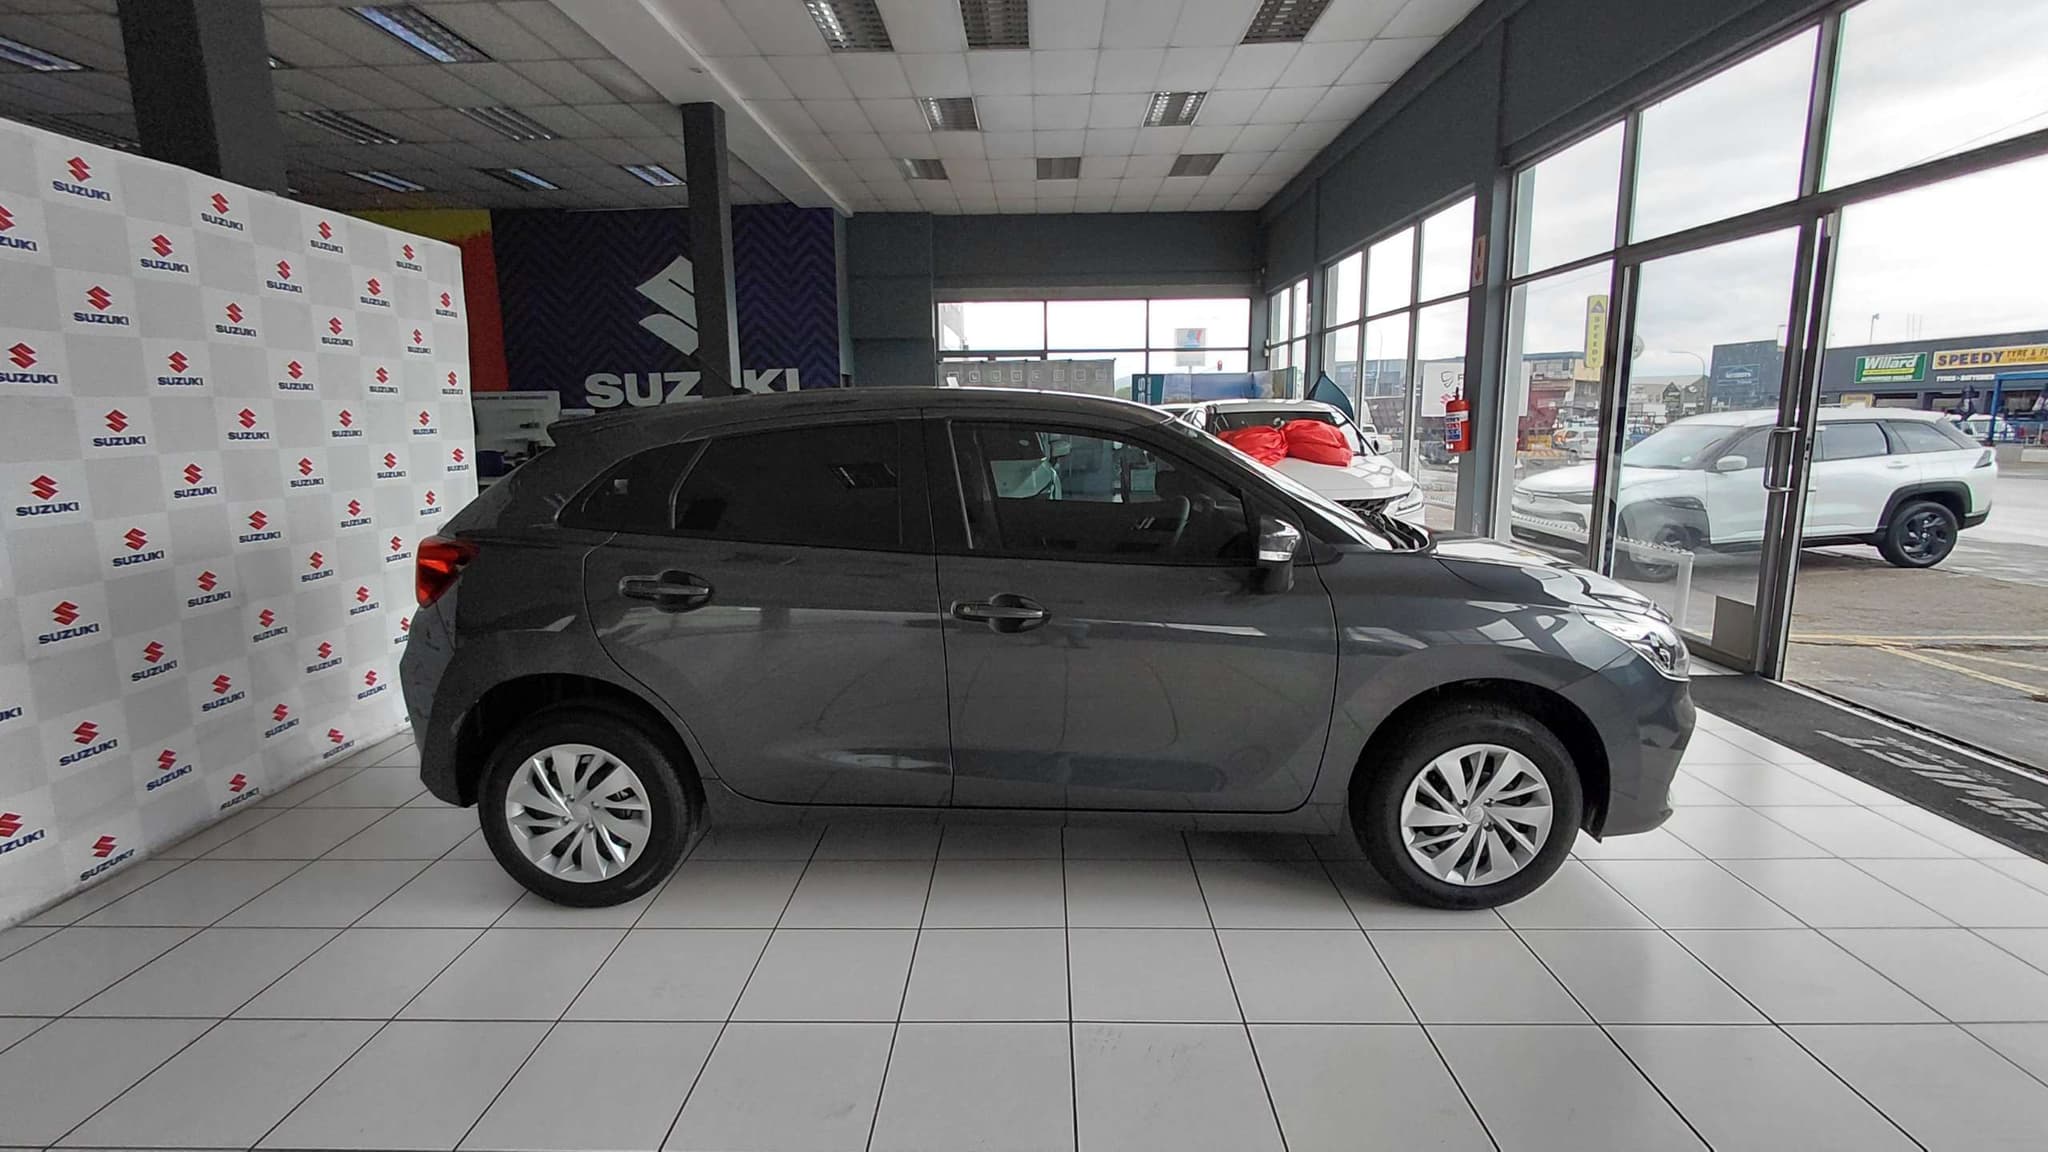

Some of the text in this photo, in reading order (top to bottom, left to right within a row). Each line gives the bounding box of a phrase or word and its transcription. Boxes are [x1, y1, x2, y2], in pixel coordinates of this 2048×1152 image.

[53, 181, 111, 201] SUZUKI
[201, 213, 243, 231] SUZUKI
[311, 240, 343, 254] SUZUKI
[140, 259, 189, 273] SUZUKI
[267, 280, 302, 293] SUZUKI
[360, 297, 390, 307] SUZUKI
[73, 312, 129, 325] SUZUKI
[216, 325, 256, 337] SUZUKI
[322, 337, 353, 346] SUZUKI
[1865, 355, 1918, 369] Willard
[1938, 351, 2003, 366] SPEEDY
[158, 377, 203, 385] SUZUKI
[278, 382, 313, 390] SUZUKI
[584, 369, 800, 408] SUZKI
[93, 436, 146, 446] SUZUKI
[228, 432, 269, 440] SUZUKI
[377, 471, 406, 479] SUZUKI
[291, 478, 324, 487] SUZUKI
[174, 487, 217, 498] SUZUKI
[16, 502, 79, 516] SUZUKI
[341, 518, 371, 528] SUZUKI
[239, 532, 281, 543] SUZUKI
[113, 551, 164, 567] SUZUKI
[301, 570, 333, 582] SUZUKI
[188, 591, 231, 607] SUZUKI
[350, 602, 379, 615] SUZUKI
[39, 624, 99, 644] SUZUKI
[253, 626, 288, 642] SUZUKI
[131, 660, 177, 681] SUZUKI
[306, 658, 342, 673] SUZUKI
[357, 684, 386, 700] SUZUKI
[202, 691, 245, 712] SUZUKI
[265, 719, 299, 738] SUZUKI
[59, 739, 117, 766] SUZUKI
[146, 765, 192, 791] SUZUKI
[220, 787, 259, 810] SUZUKI
[0, 830, 44, 854] ZUKI
[80, 849, 134, 881] SUZUKI
